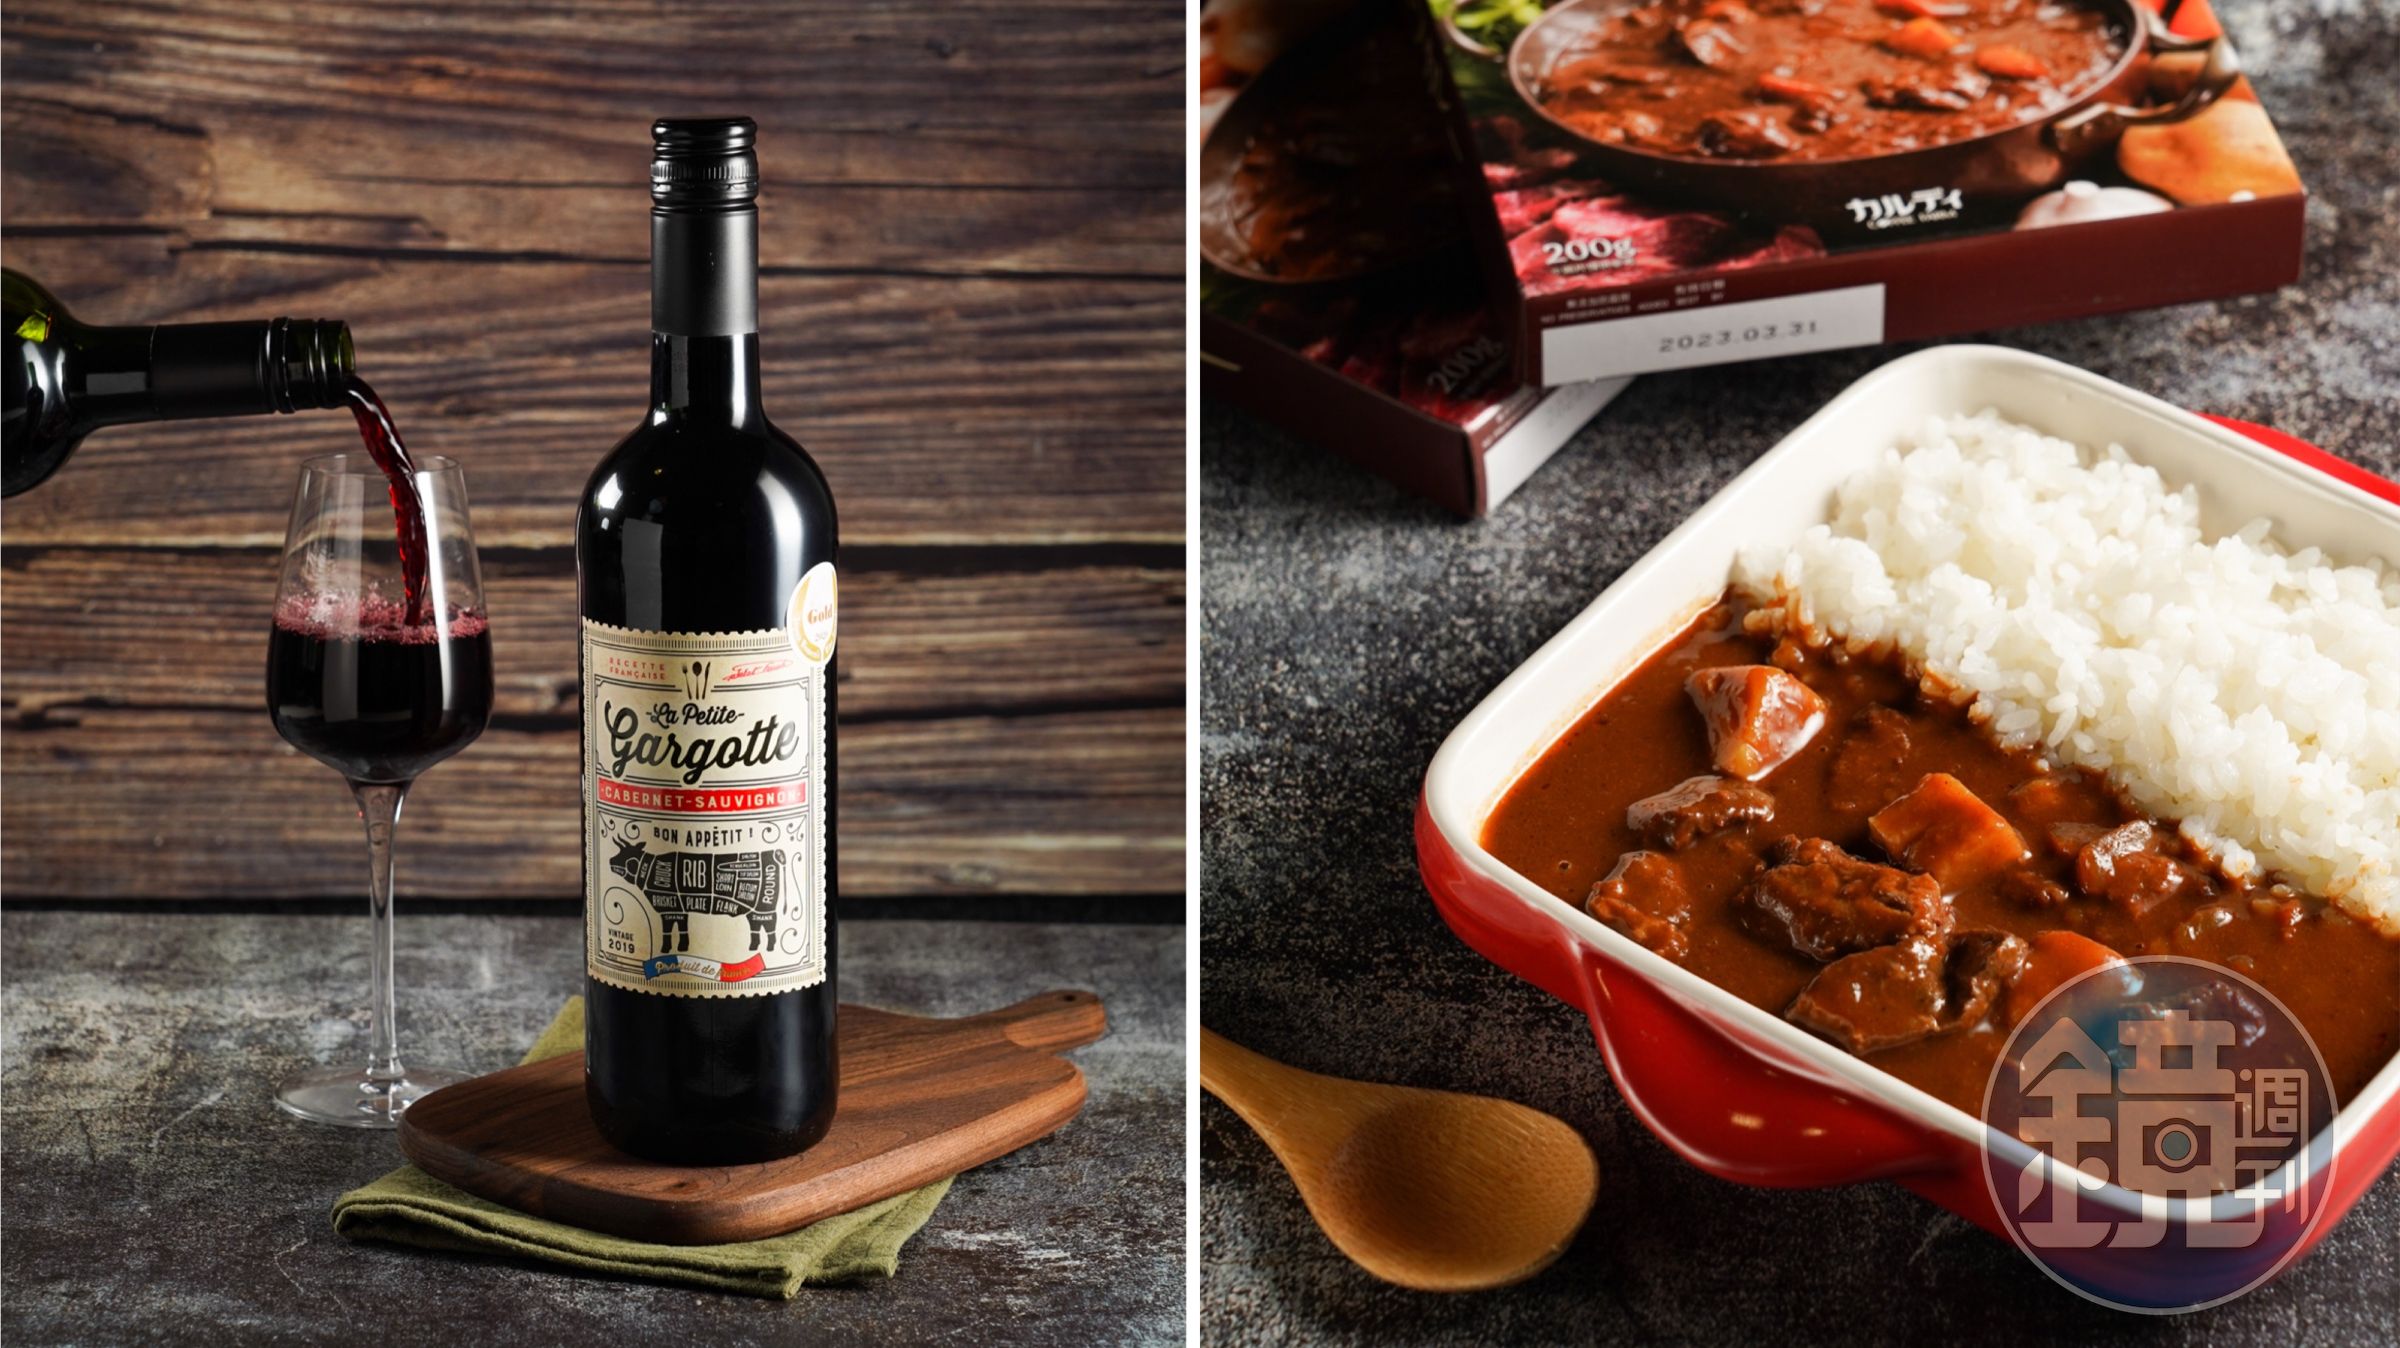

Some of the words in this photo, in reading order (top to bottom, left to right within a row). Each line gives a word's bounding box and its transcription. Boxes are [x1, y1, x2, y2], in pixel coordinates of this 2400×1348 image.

[1844, 186, 1963, 222] カルディ
[1542, 237, 1637, 266] 200g
[1659, 320, 1820, 353] 2023.03.31
[807, 604, 833, 625] Gold
[609, 656, 666, 671] RECETTE
[604, 699, 800, 786] Gargotte
[654, 826, 678, 845] BON
[654, 860, 673, 888] CHUCK
[682, 858, 707, 889] RIB
[715, 872, 735, 884] SHORT
[715, 883, 732, 893] LOIN
[762, 864, 777, 904] ROUND
[652, 895, 678, 908] BRISKET
[686, 896, 707, 911] PLATE
[716, 900, 740, 915] FLANK
[608, 928, 635, 942] VINTAGE
[608, 939, 636, 955] 2019
[655, 960, 701, 976] Produit
[701, 964, 716, 975] de
